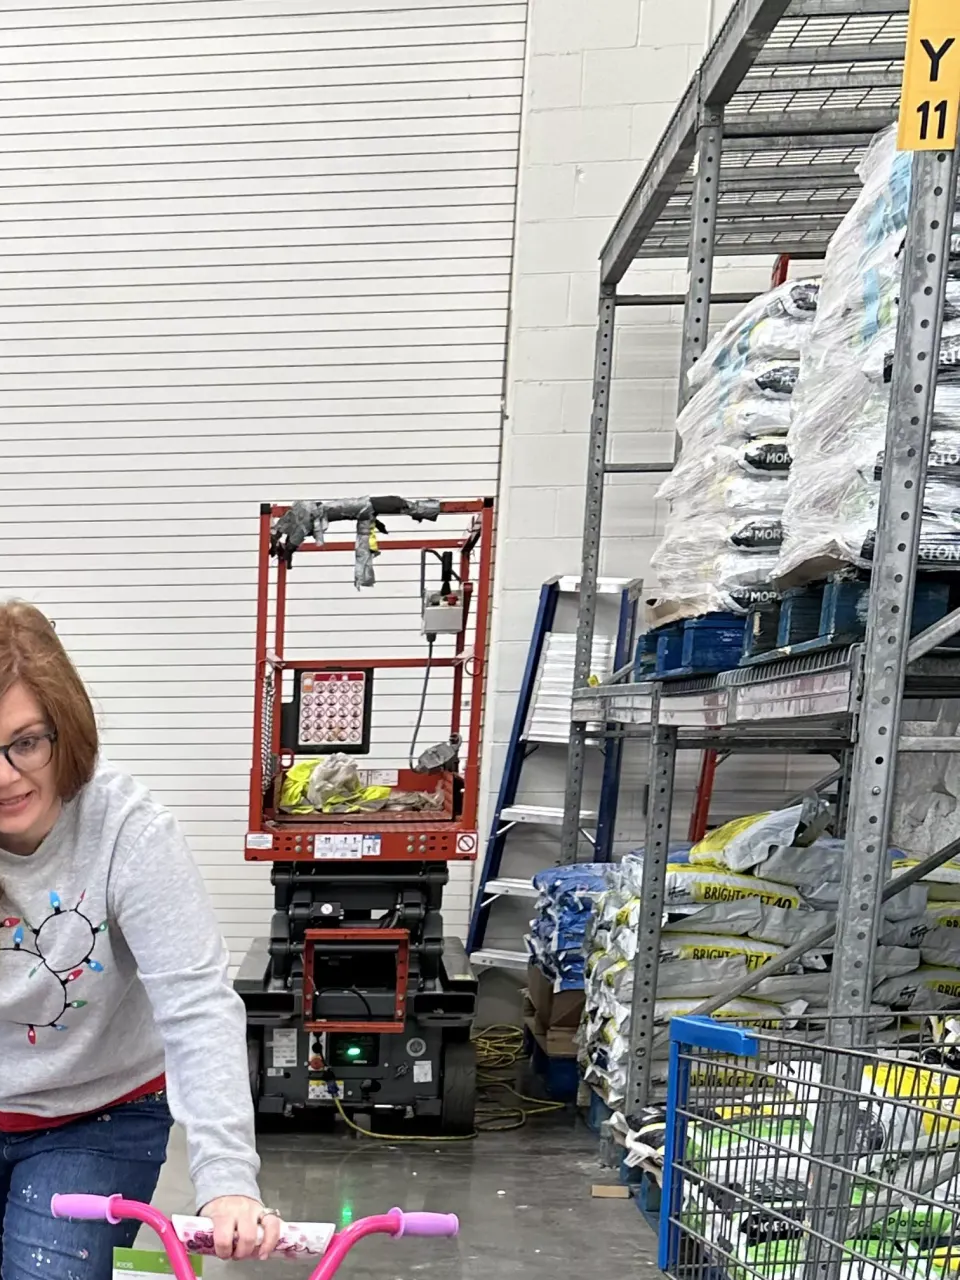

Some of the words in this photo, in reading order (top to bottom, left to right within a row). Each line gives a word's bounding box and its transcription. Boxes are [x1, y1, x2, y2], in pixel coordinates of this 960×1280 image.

[920, 38, 956, 82] Y
[917, 100, 948, 140] 11
[765, 453, 791, 464] MOR
[928, 451, 960, 465] RTO
[754, 529, 782, 541] MOR
[918, 545, 960, 560] RTON
[751, 591, 778, 602] MOR
[703, 886, 741, 901] BRIGHT
[770, 899, 792, 910] 40
[888, 1216, 931, 1228] Poect
